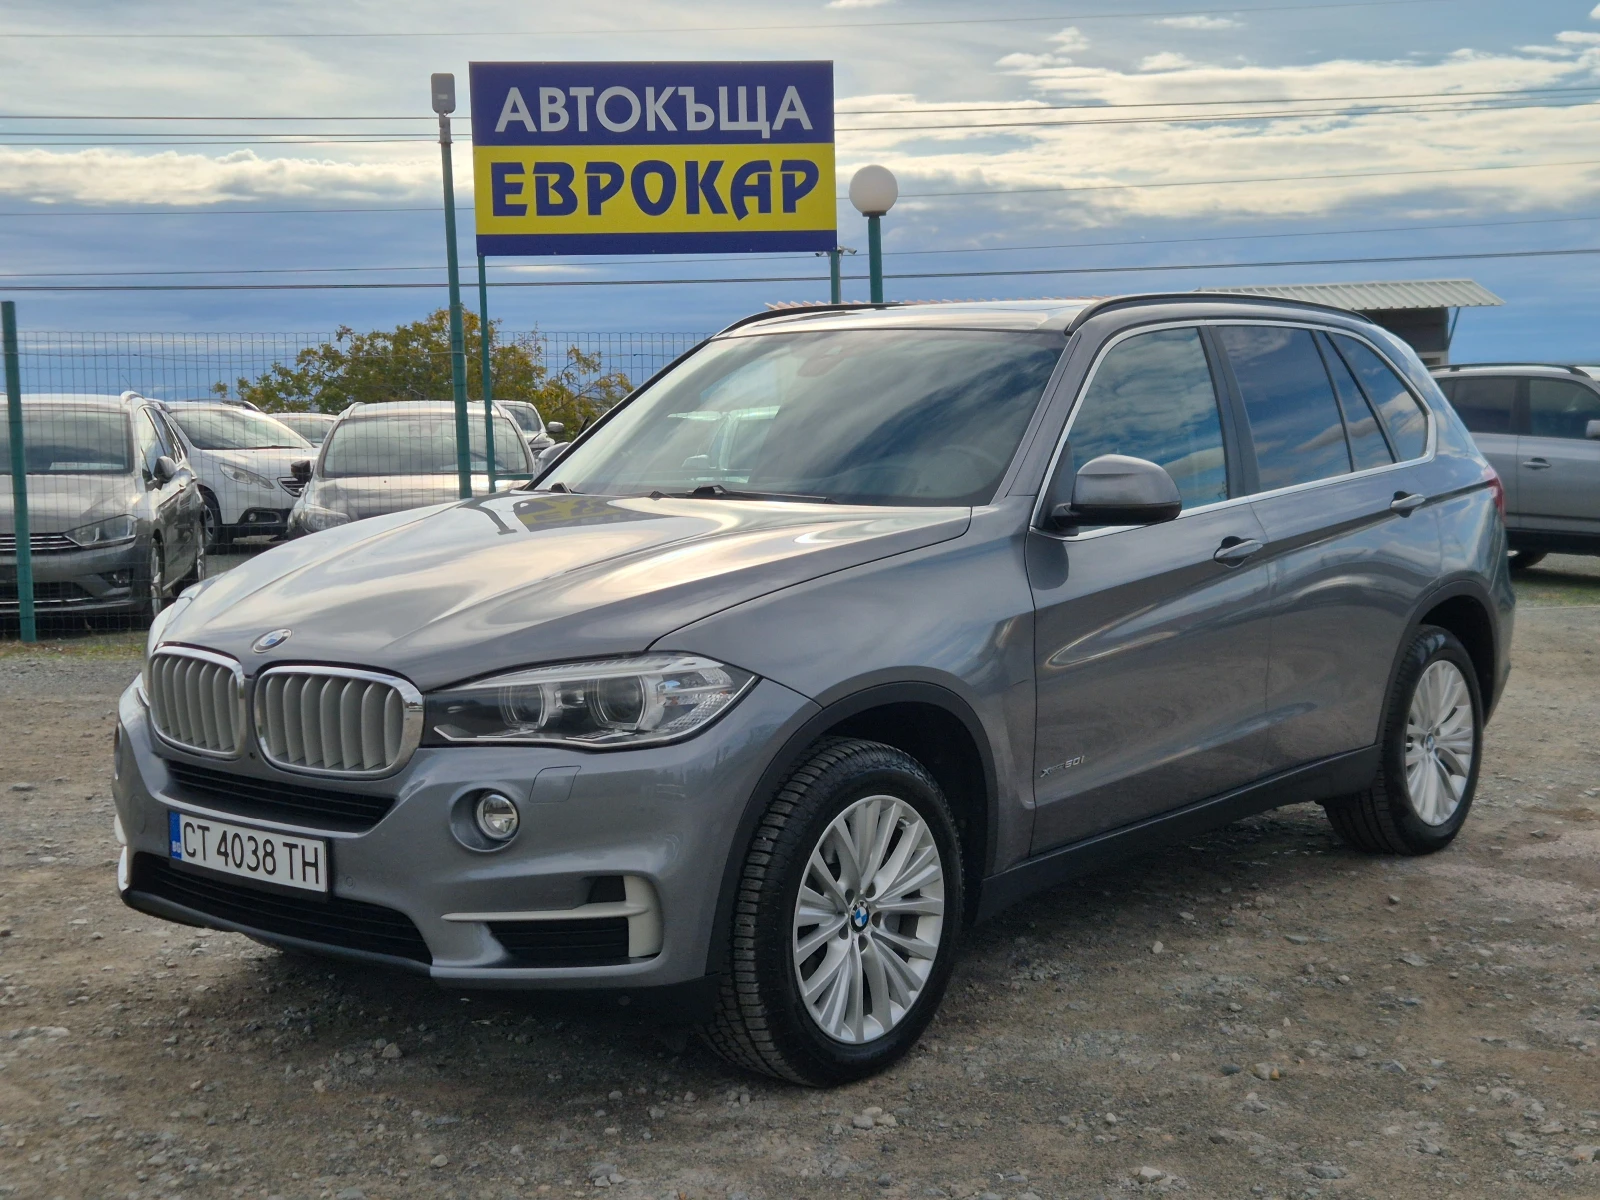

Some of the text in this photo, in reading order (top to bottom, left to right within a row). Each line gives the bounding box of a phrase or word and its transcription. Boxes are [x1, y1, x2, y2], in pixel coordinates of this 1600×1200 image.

[495, 85, 813, 139] АВТОКЪЩА
[490, 159, 820, 221] ЕВРОКАР
[183, 821, 320, 885] CT 4038 TH
